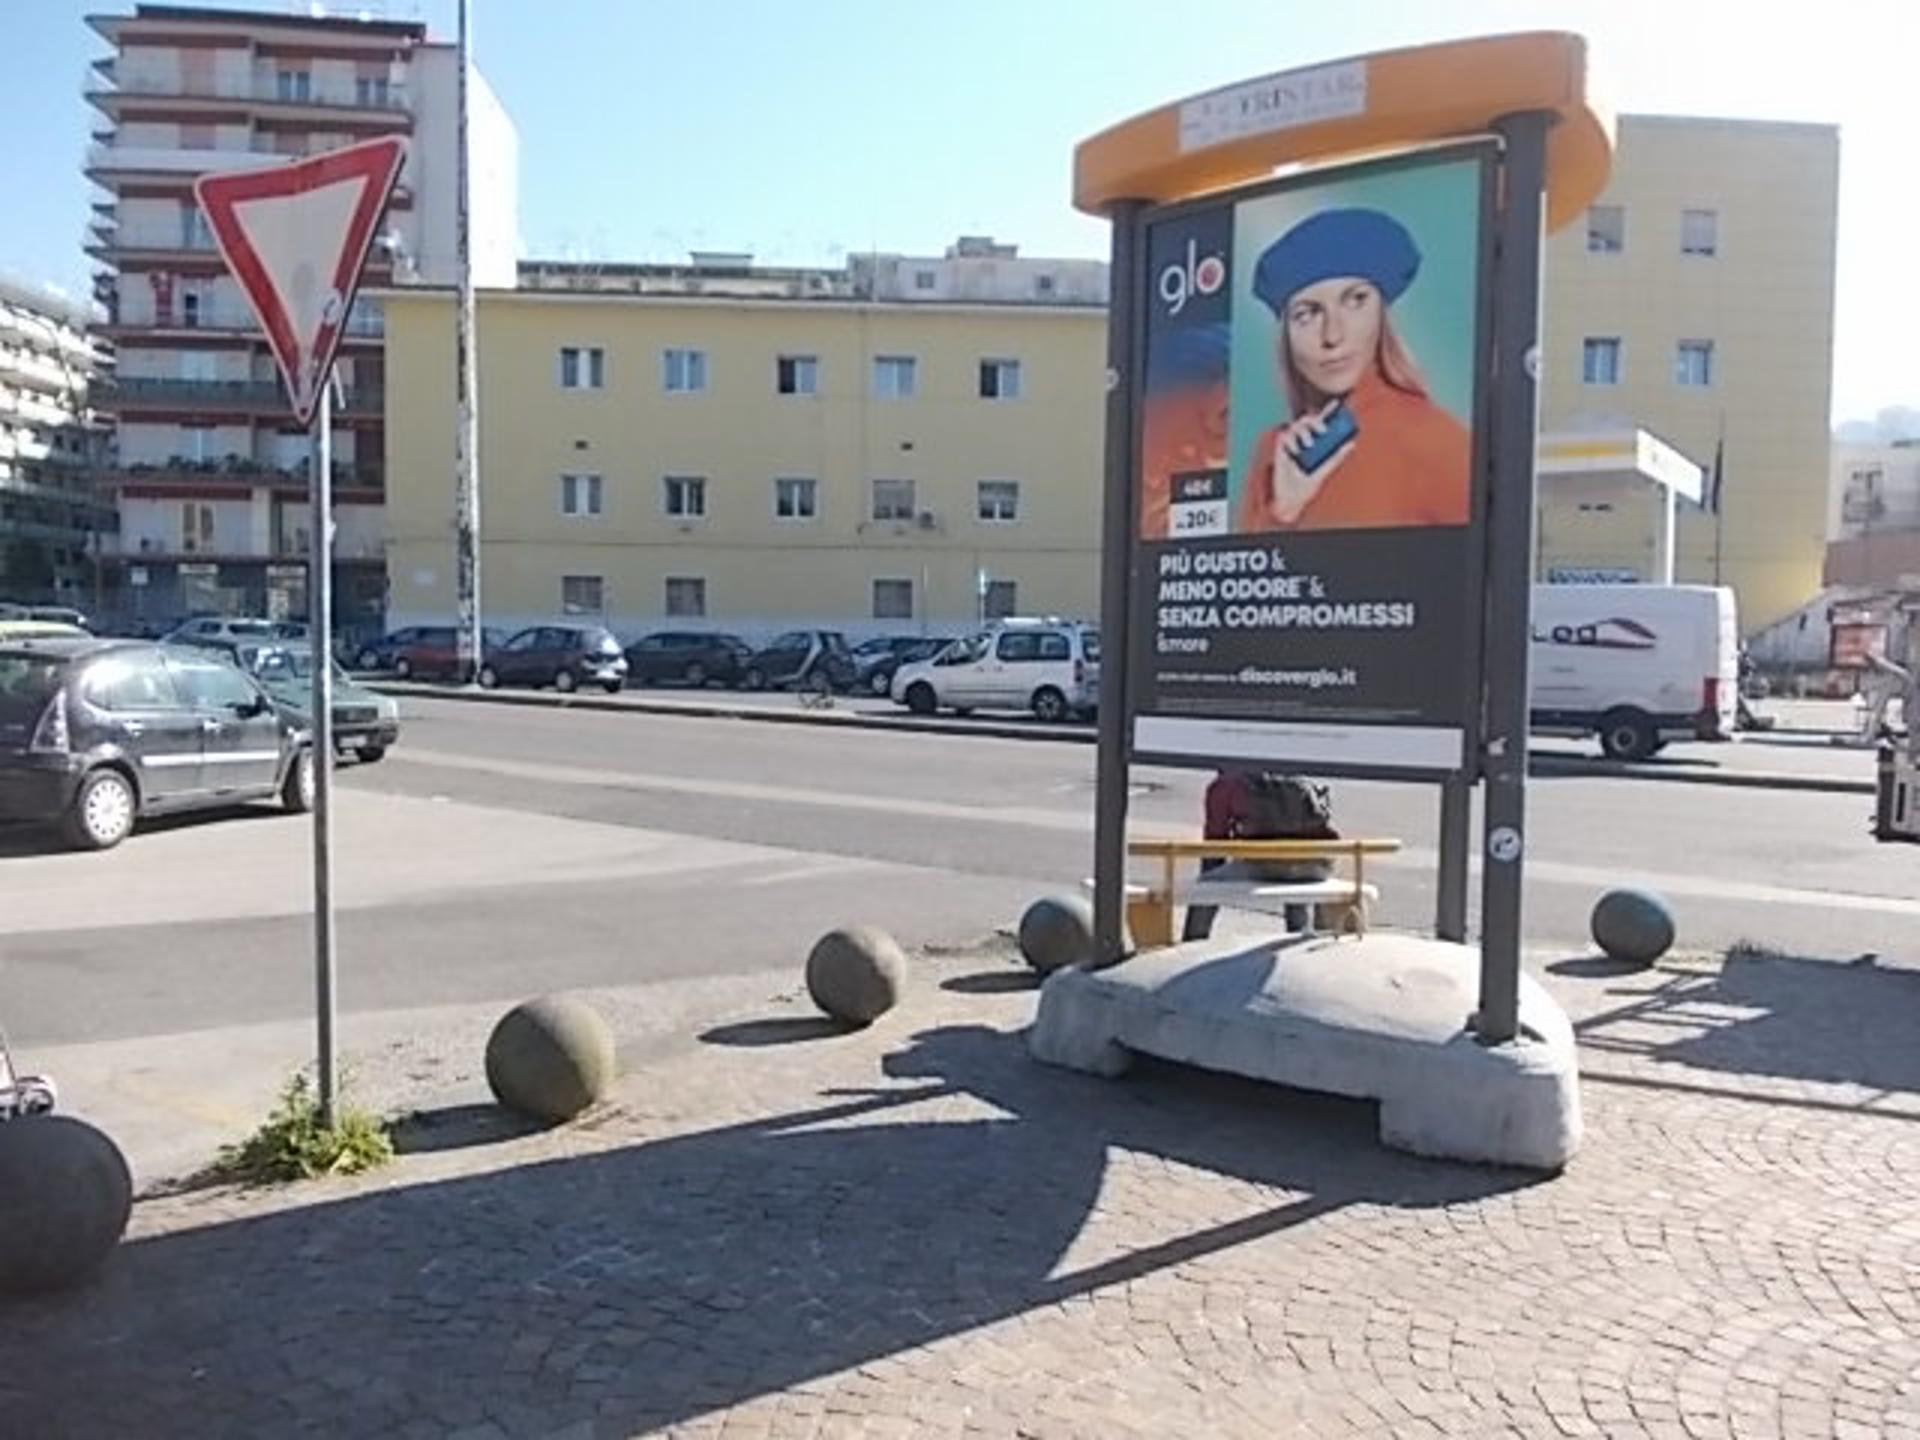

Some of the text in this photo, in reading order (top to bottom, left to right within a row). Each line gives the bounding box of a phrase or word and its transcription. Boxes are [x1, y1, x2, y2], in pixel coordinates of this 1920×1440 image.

[1160, 239, 1224, 314] glo
[1160, 548, 1191, 576] PIÙ
[1194, 549, 1268, 574] GUSTO
[1159, 579, 1217, 601] MENO
[1158, 602, 1414, 628] SENZA COMPROMESSI
[1238, 666, 1357, 688] discoverglo.it
